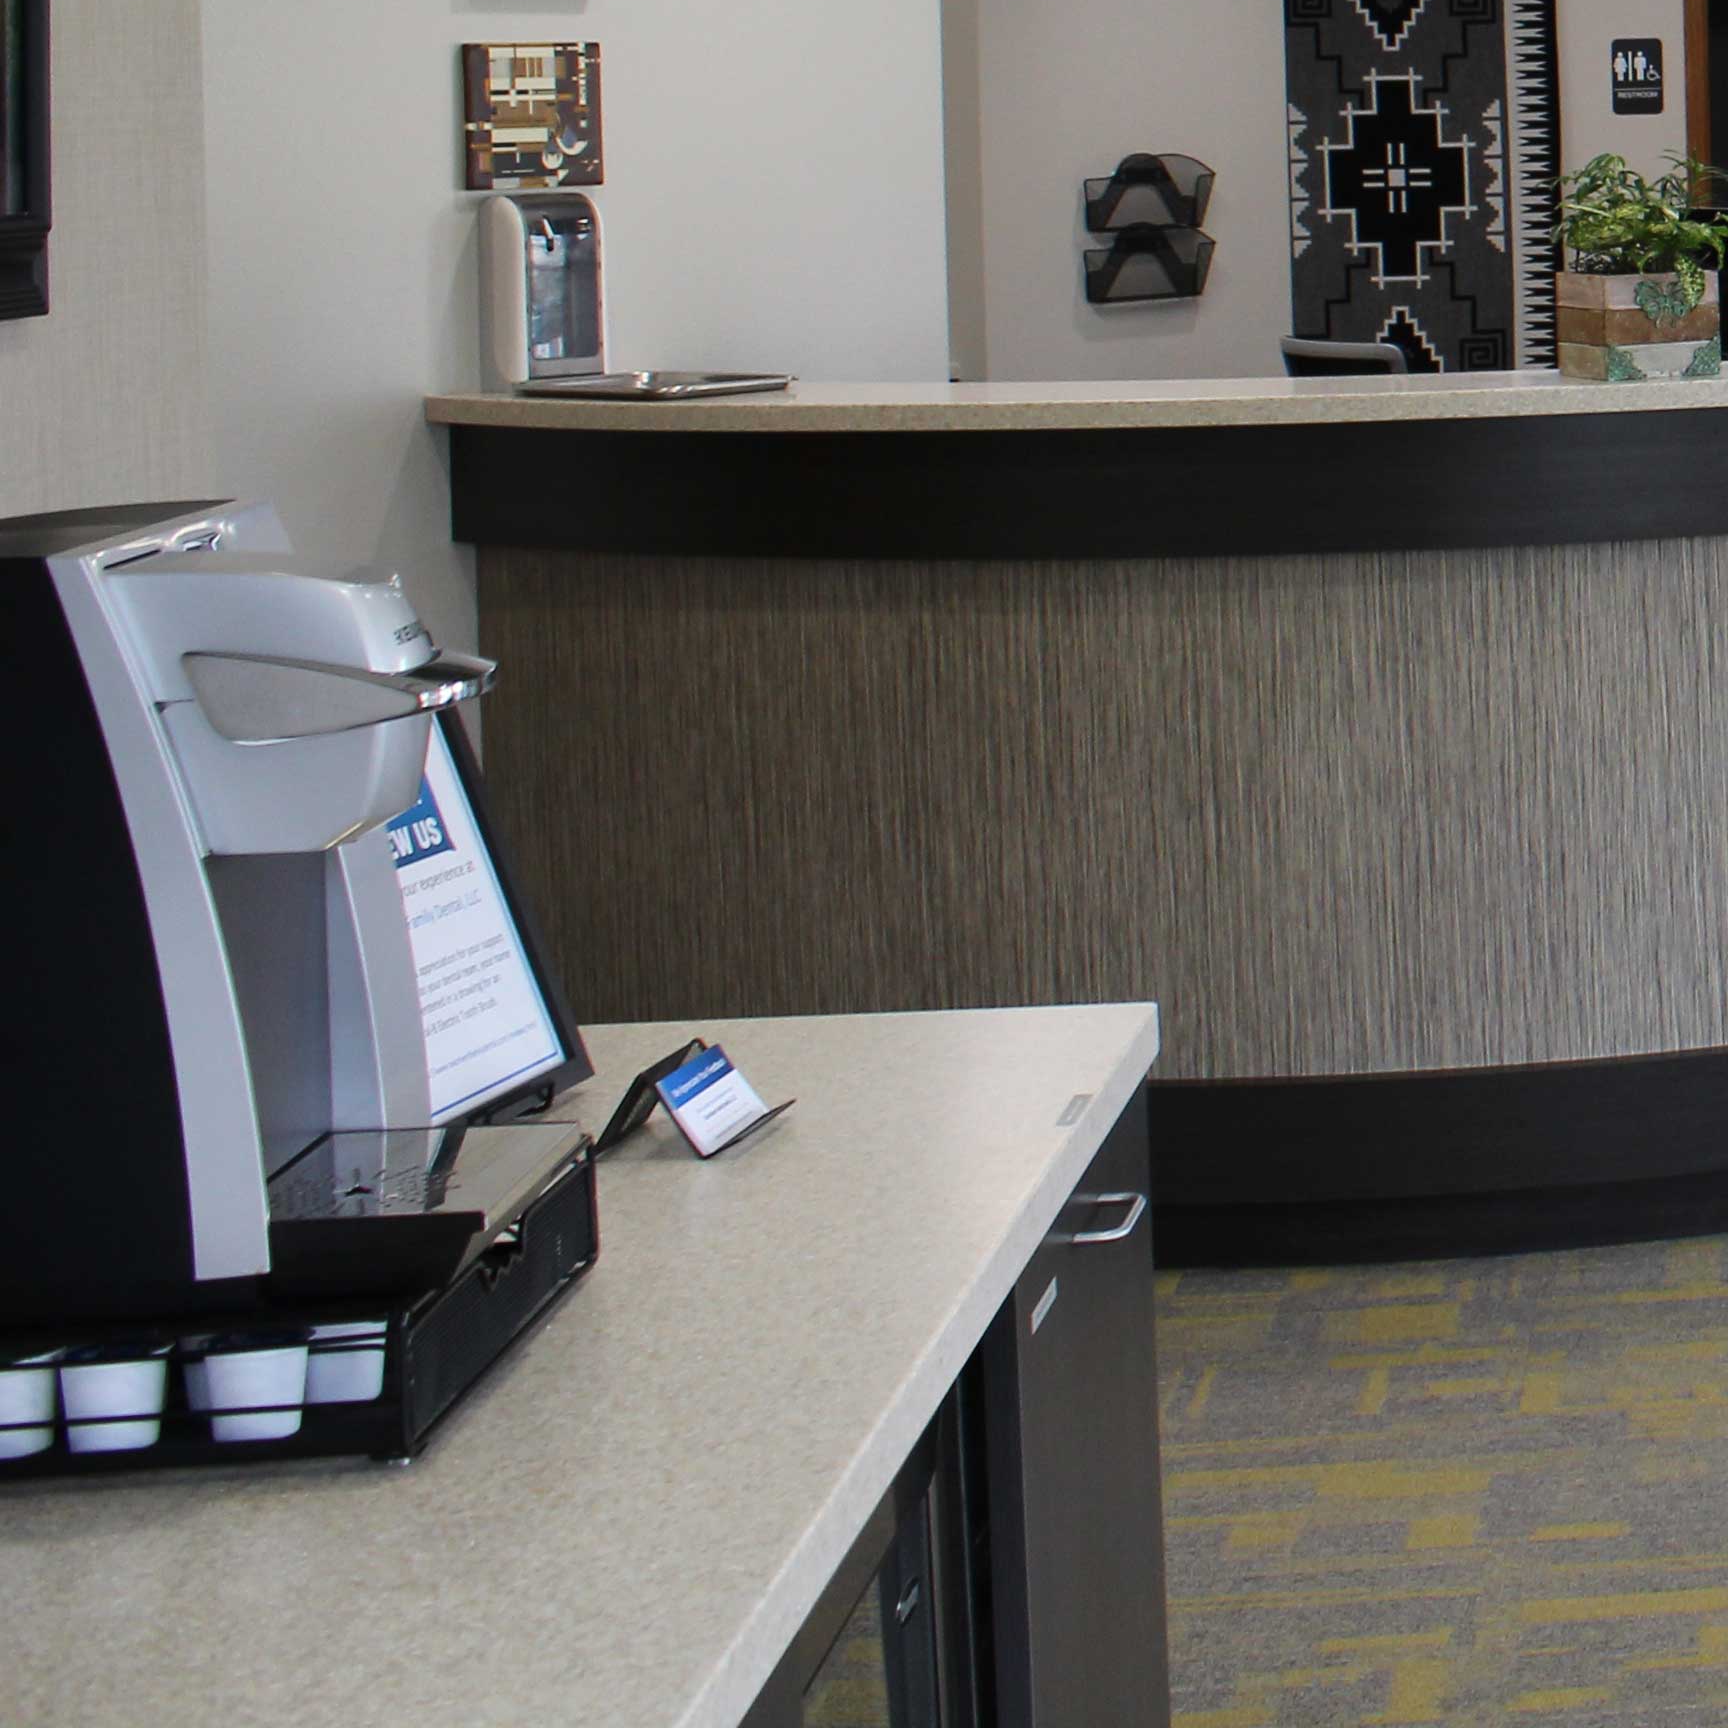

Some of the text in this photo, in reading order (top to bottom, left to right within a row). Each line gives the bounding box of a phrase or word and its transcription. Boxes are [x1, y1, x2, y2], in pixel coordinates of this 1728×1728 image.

[1616, 91, 1659, 99] RESTROOM
[412, 816, 443, 850] US
[401, 877, 419, 897] our
[419, 866, 467, 892] experience
